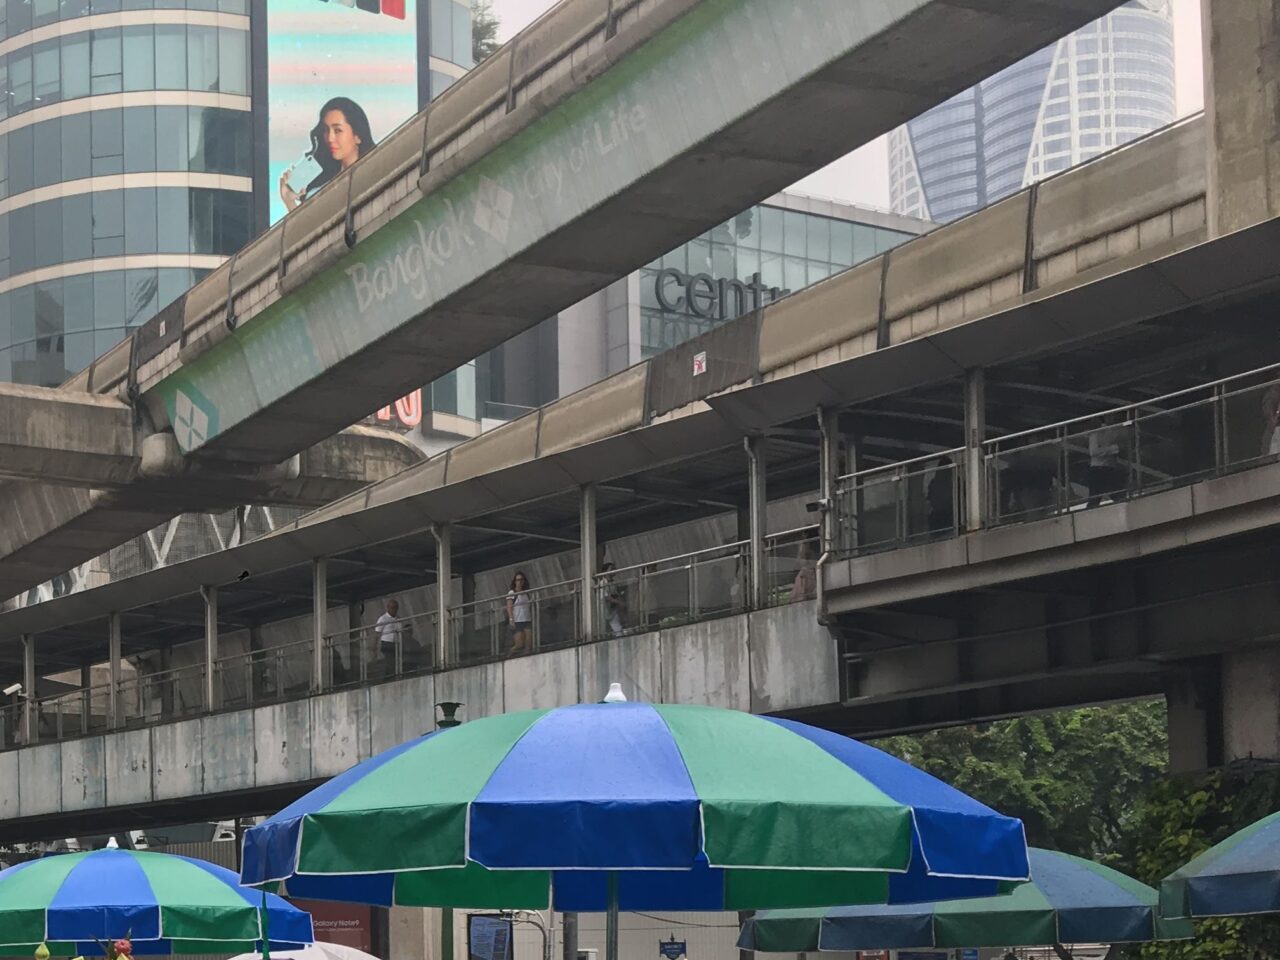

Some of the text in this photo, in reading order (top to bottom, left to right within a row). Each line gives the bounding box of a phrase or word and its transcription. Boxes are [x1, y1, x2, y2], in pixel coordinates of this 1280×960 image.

[593, 99, 648, 155] Life
[344, 198, 475, 313] Bangkok
[313, 919, 360, 928] Galaxy Note9
